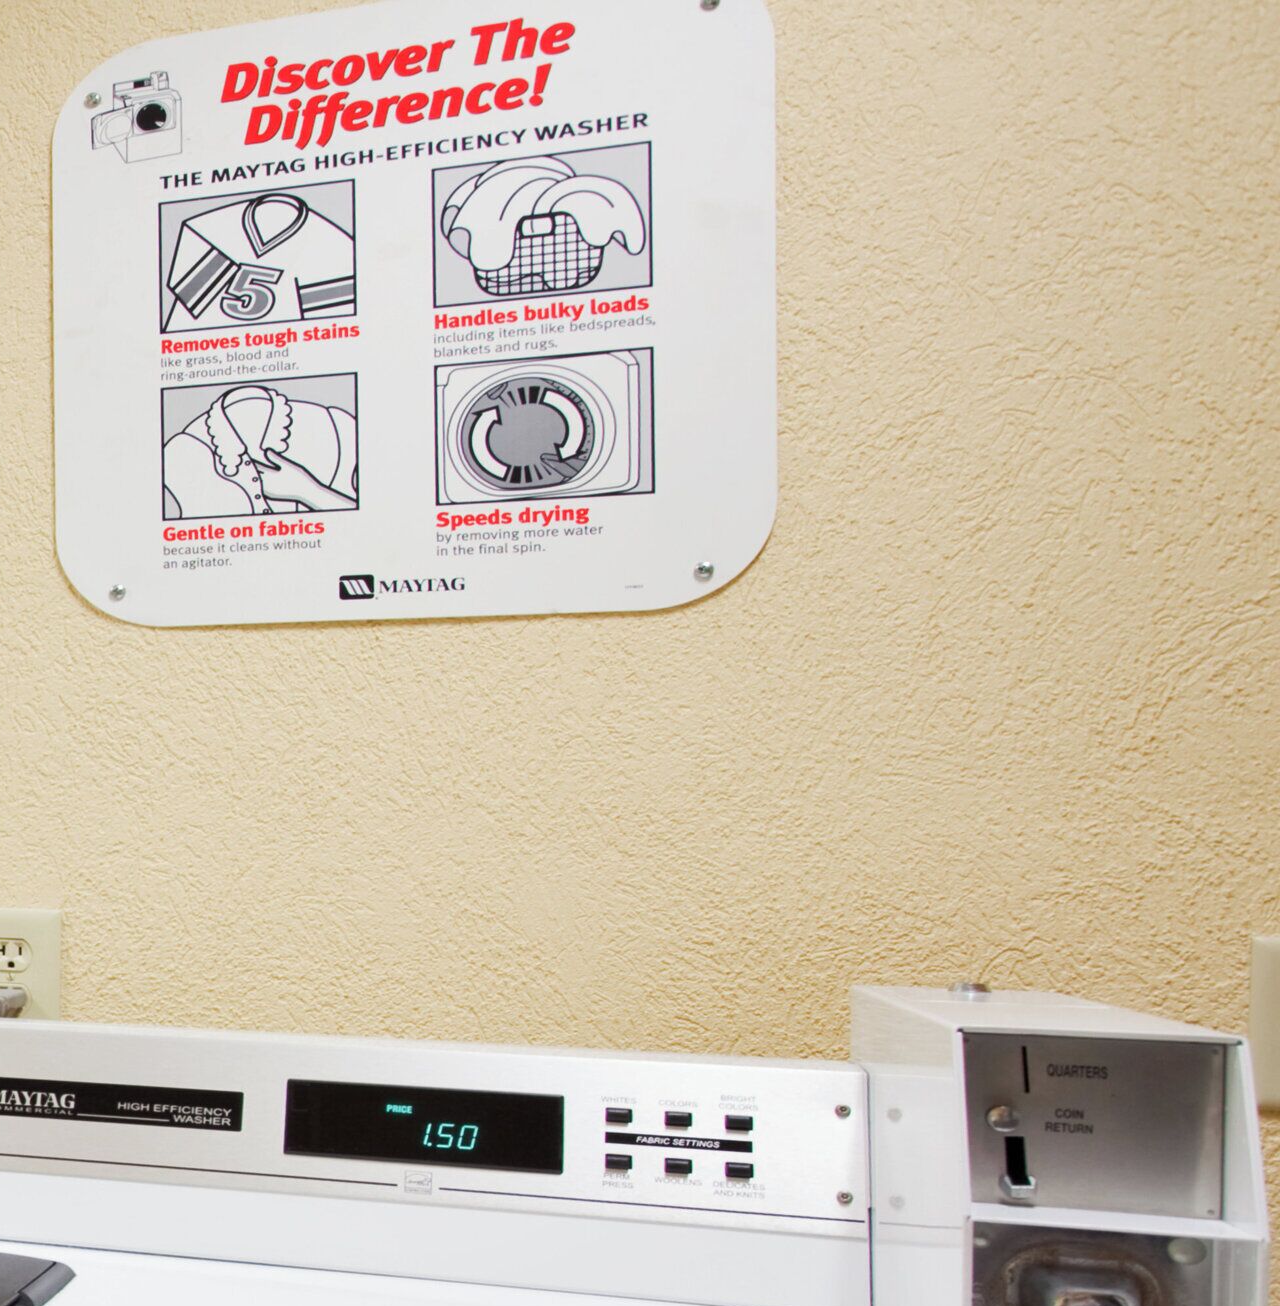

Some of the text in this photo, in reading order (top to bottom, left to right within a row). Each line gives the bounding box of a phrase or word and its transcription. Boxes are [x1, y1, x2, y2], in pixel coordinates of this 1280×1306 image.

[221, 17, 576, 103] Discover The
[244, 63, 552, 150] Difference!
[160, 112, 649, 190] THE MAYTAG HIGH-EFFICIENCY WASHER
[220, 263, 284, 321] 5
[434, 295, 650, 330] Handles bulky loads
[161, 323, 360, 354] Removes tough stains
[434, 315, 656, 344] including items like bedspreads,
[161, 348, 289, 368] like grass, blood and
[434, 340, 558, 358] blankets and rugs.
[161, 361, 299, 382] ring-around-the-collar.
[436, 505, 590, 531] Speeds drying
[163, 519, 325, 542] Gentle on fabrics
[436, 524, 603, 543] by removing more water
[163, 538, 322, 556] because it cleans without
[436, 541, 546, 556] in the final spin.
[163, 556, 233, 570] an agitator.
[379, 577, 466, 594] MAYTAG
[1046, 1063, 1109, 1080] QUARTERS
[385, 1104, 413, 1114] PRICE
[601, 1095, 638, 1105] WHITES
[658, 1099, 699, 1109] COLORS
[117, 1101, 233, 1118] HIGH EFFICIENCY
[1054, 1108, 1085, 1119] COIN
[173, 1113, 232, 1127] WASHER
[1044, 1121, 1094, 1134] RETURN
[423, 1123, 479, 1150] 1.50
[636, 1135, 721, 1149] FABRIC SETTINGS
